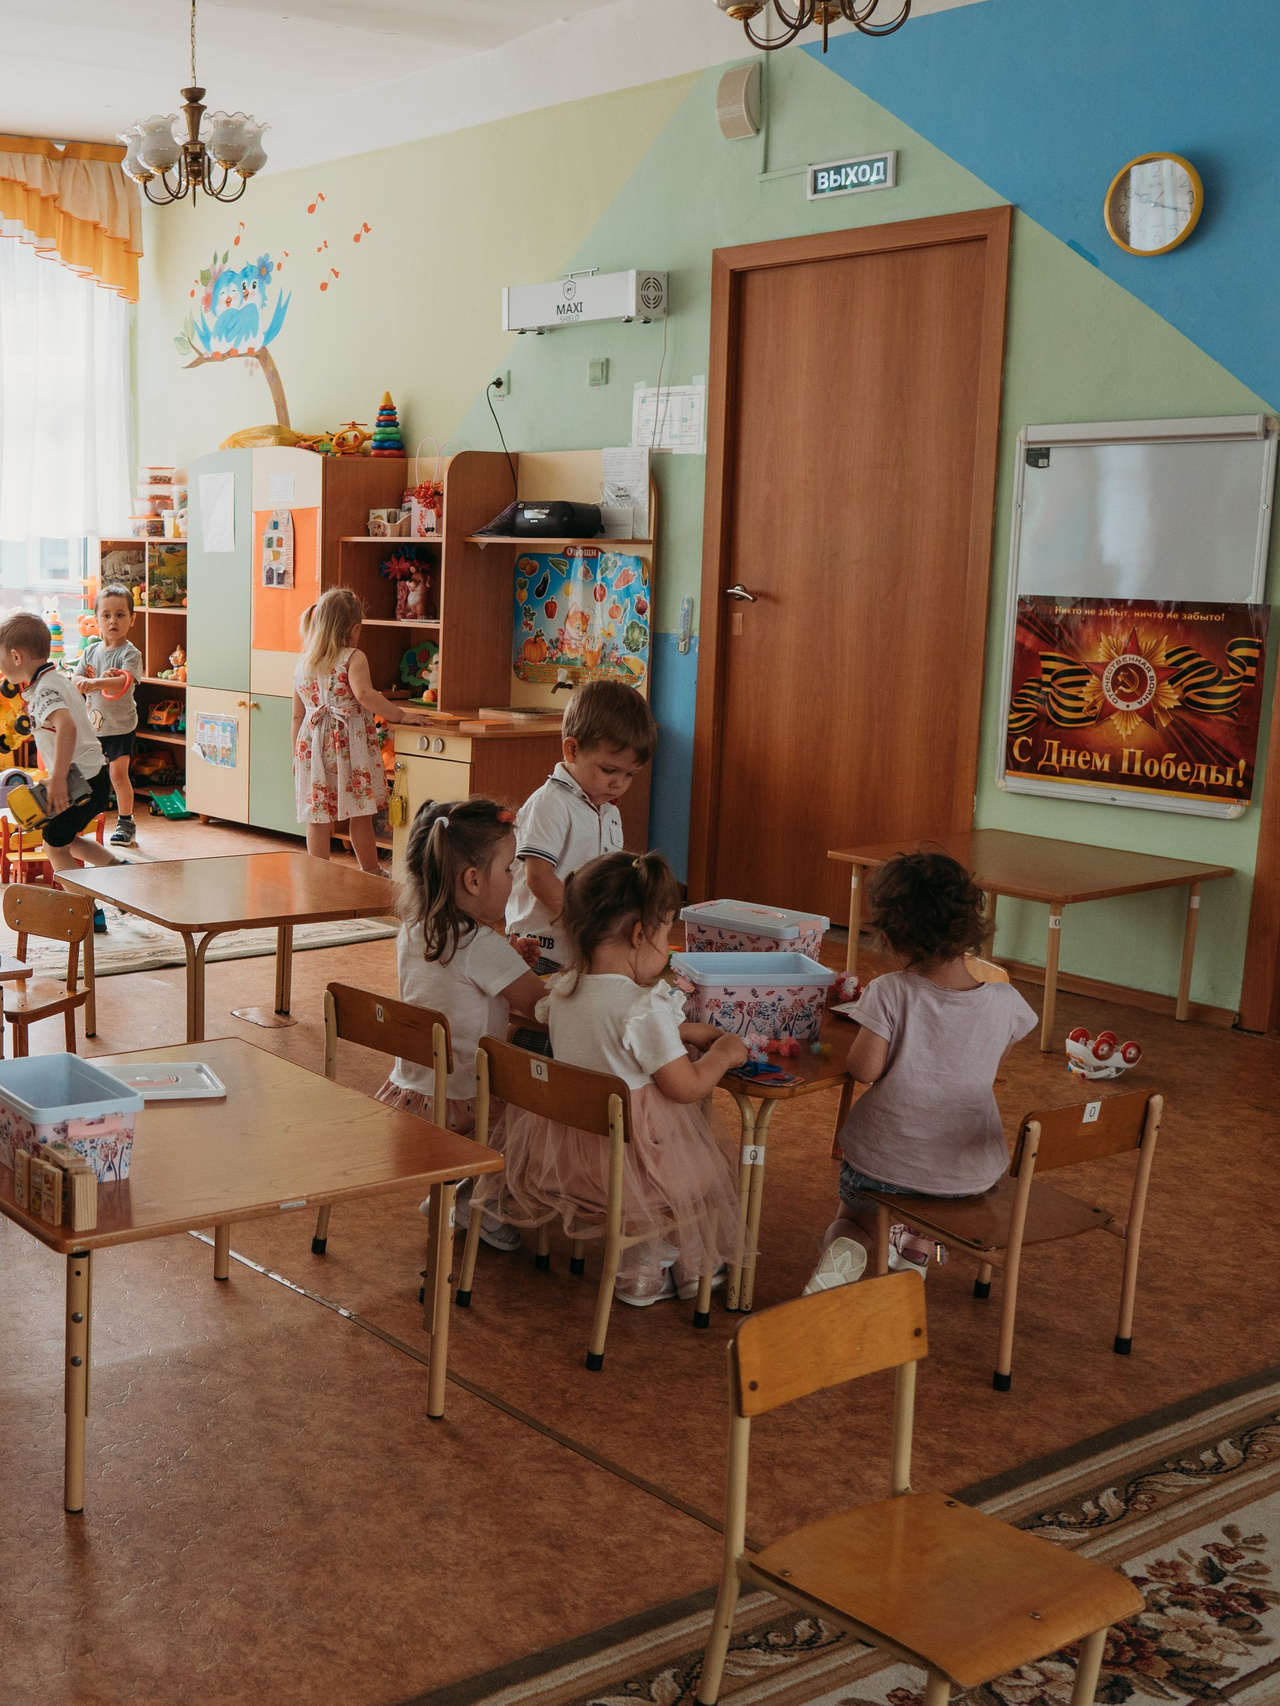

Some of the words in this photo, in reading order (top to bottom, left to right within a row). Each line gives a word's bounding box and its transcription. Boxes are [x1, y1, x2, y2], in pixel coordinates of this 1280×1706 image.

[817, 161, 885, 190] ВЫХОД
[1179, 173, 1188, 188] 2
[1187, 190, 1195, 205] 3
[1118, 203, 1128, 217] 9
[556, 301, 583, 315] MAXI
[1054, 606, 1082, 615] Никто
[1098, 608, 1131, 618] забыт,
[1133, 611, 1164, 619] ничто
[1181, 612, 1225, 621] забыто!
[1104, 656, 1152, 705] ОТЕЧЕСТВЕННАЯ
[1012, 736, 1033, 763] С
[1037, 739, 1112, 773] Днем
[1120, 747, 1246, 788] Победы!
[526, 933, 555, 950] UB
